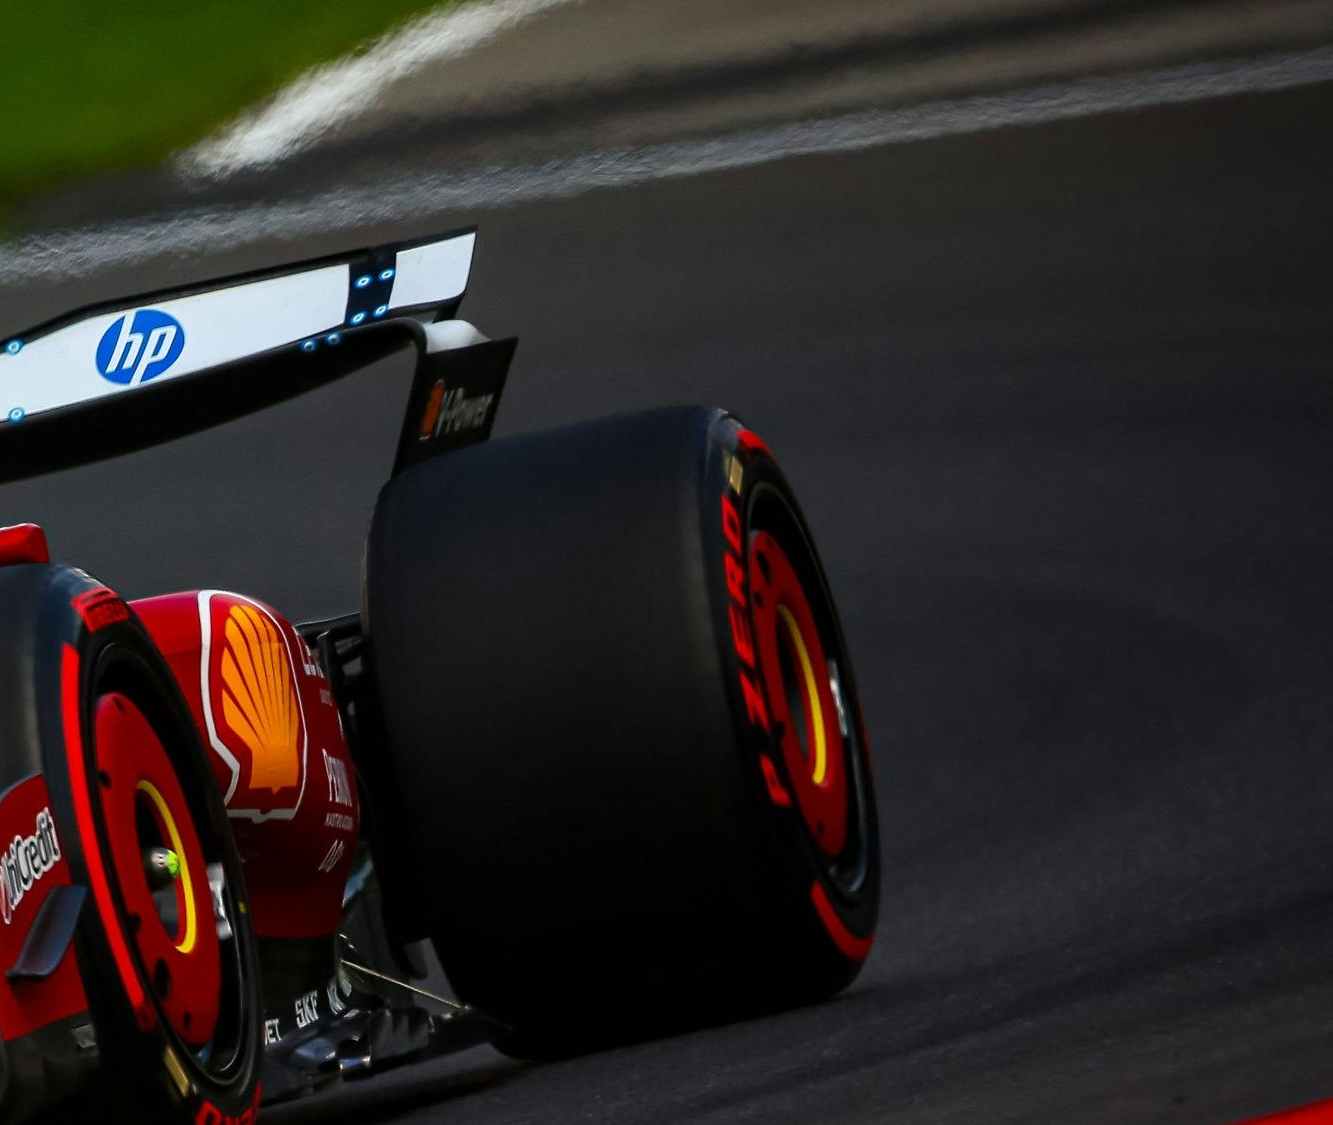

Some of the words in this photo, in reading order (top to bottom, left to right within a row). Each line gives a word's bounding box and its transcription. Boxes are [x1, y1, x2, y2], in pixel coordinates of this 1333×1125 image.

[101, 309, 181, 385] hp
[0, 806, 61, 911] UniCredit
[295, 989, 319, 1029] SKF
